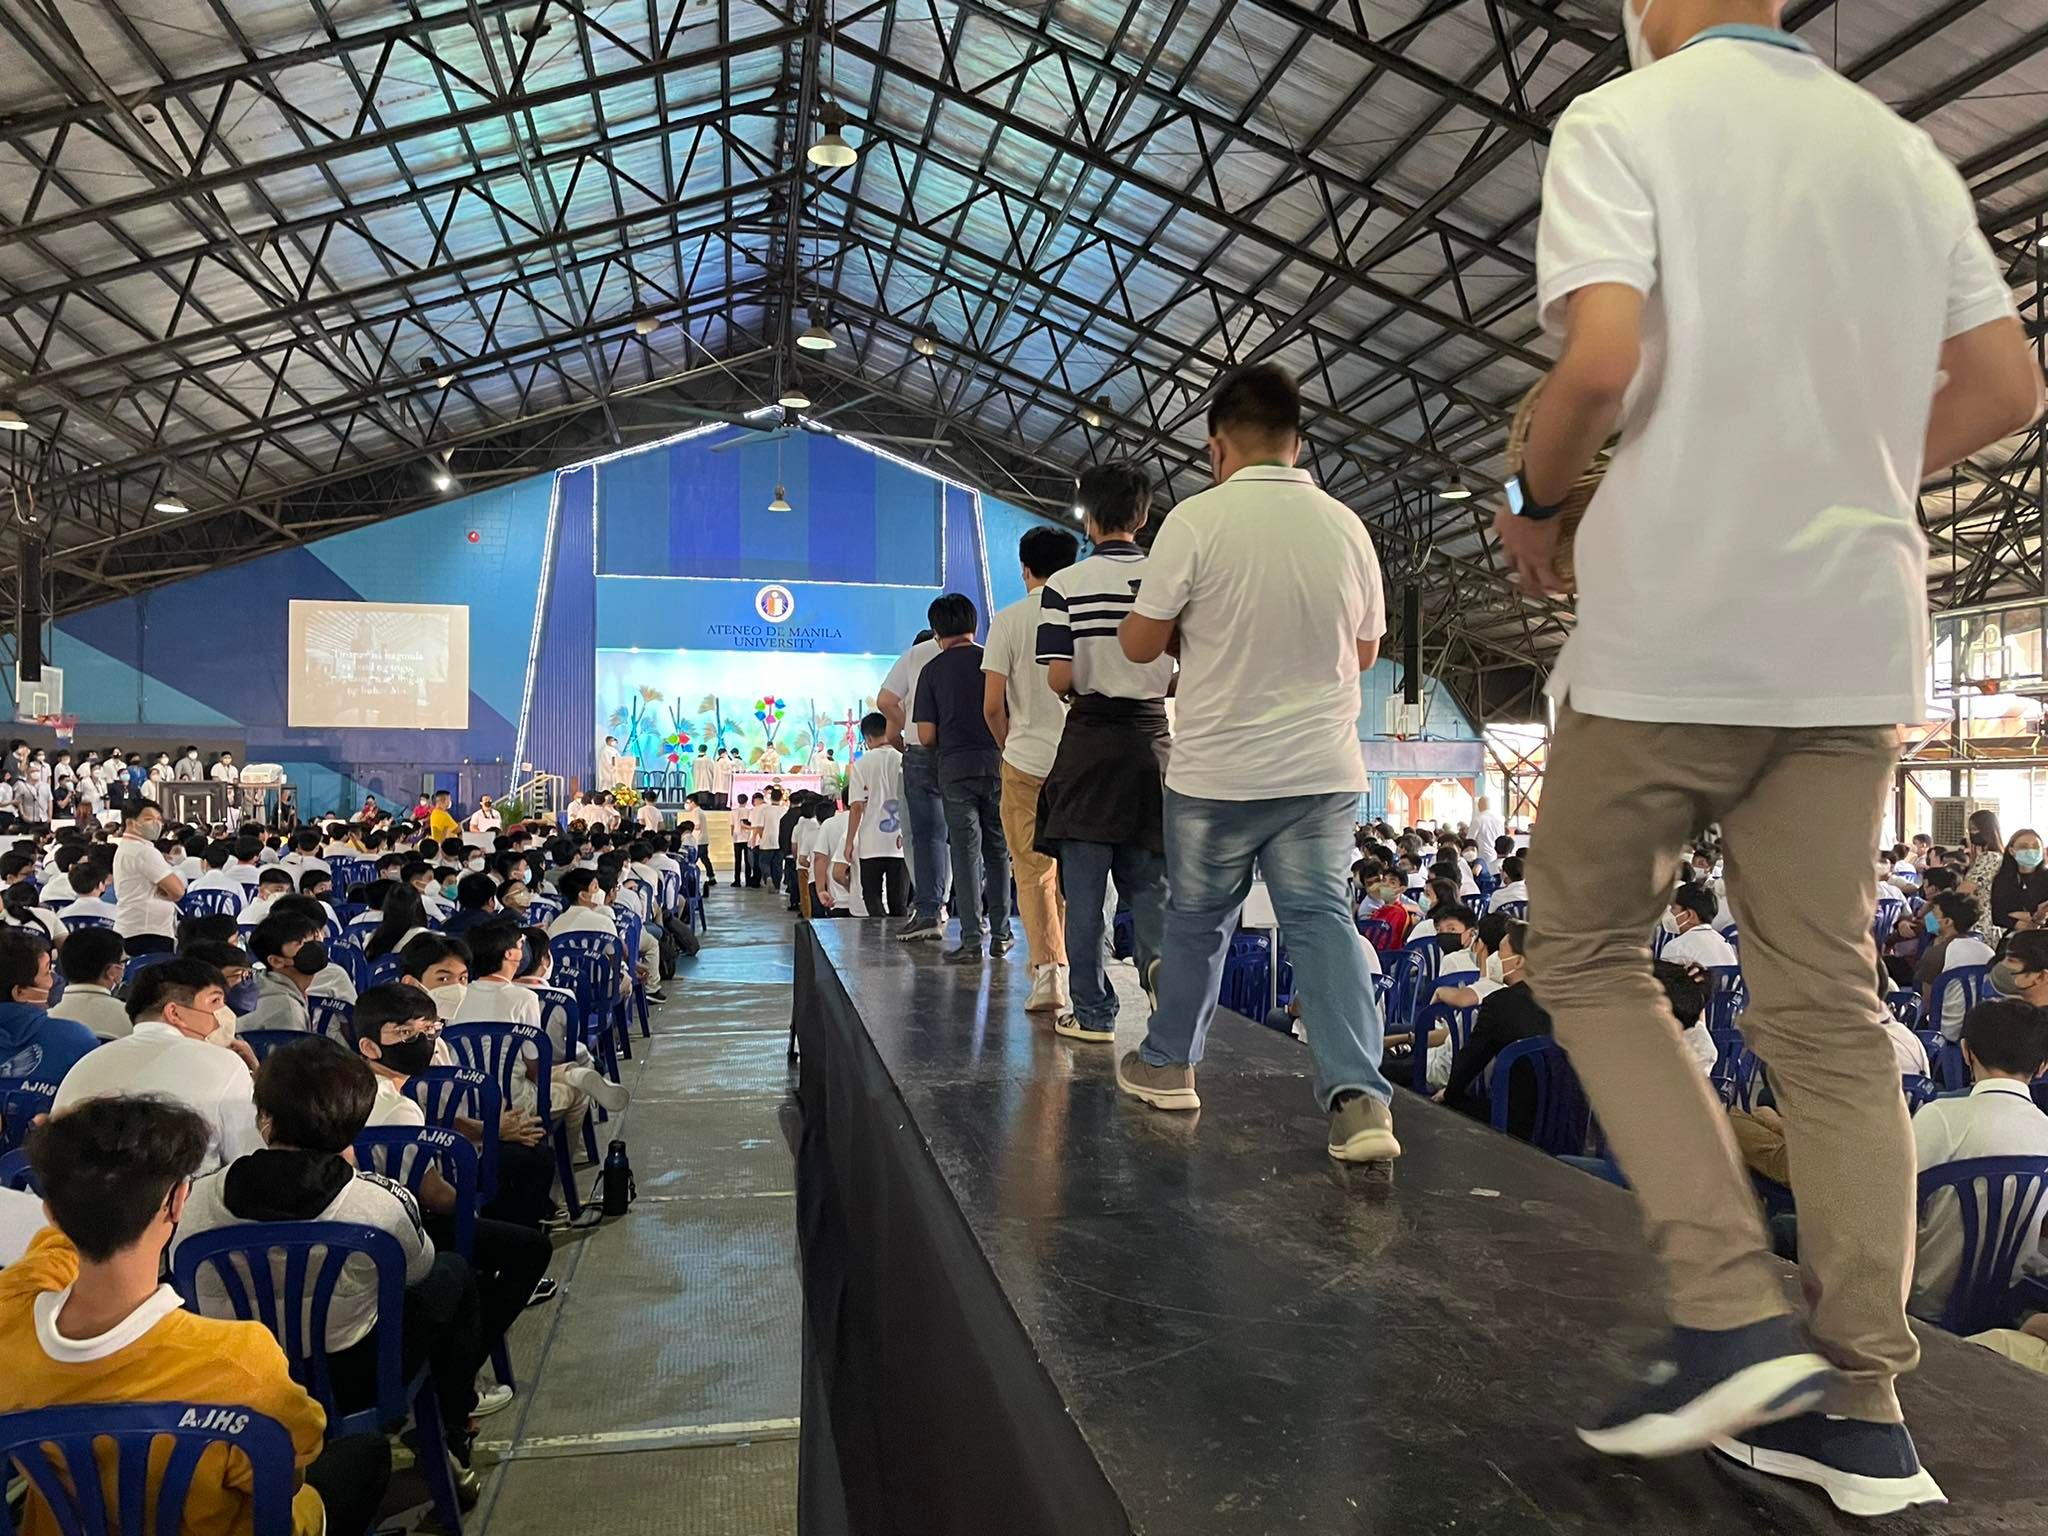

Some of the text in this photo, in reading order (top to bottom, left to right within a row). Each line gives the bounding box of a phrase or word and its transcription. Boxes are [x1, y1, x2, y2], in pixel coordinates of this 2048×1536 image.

[706, 624, 842, 638] ATENEO DE MANILA
[734, 636, 816, 649] UNIVERSITY
[560, 966, 580, 978] AJHS
[545, 991, 568, 1004] AJHS
[320, 998, 346, 1012] AJHS
[511, 1024, 539, 1039] AJHS
[454, 1069, 486, 1084] AJHS
[20, 1080, 57, 1096] AJHS
[417, 1129, 456, 1147] AJHS
[178, 1408, 250, 1434] AJHS
